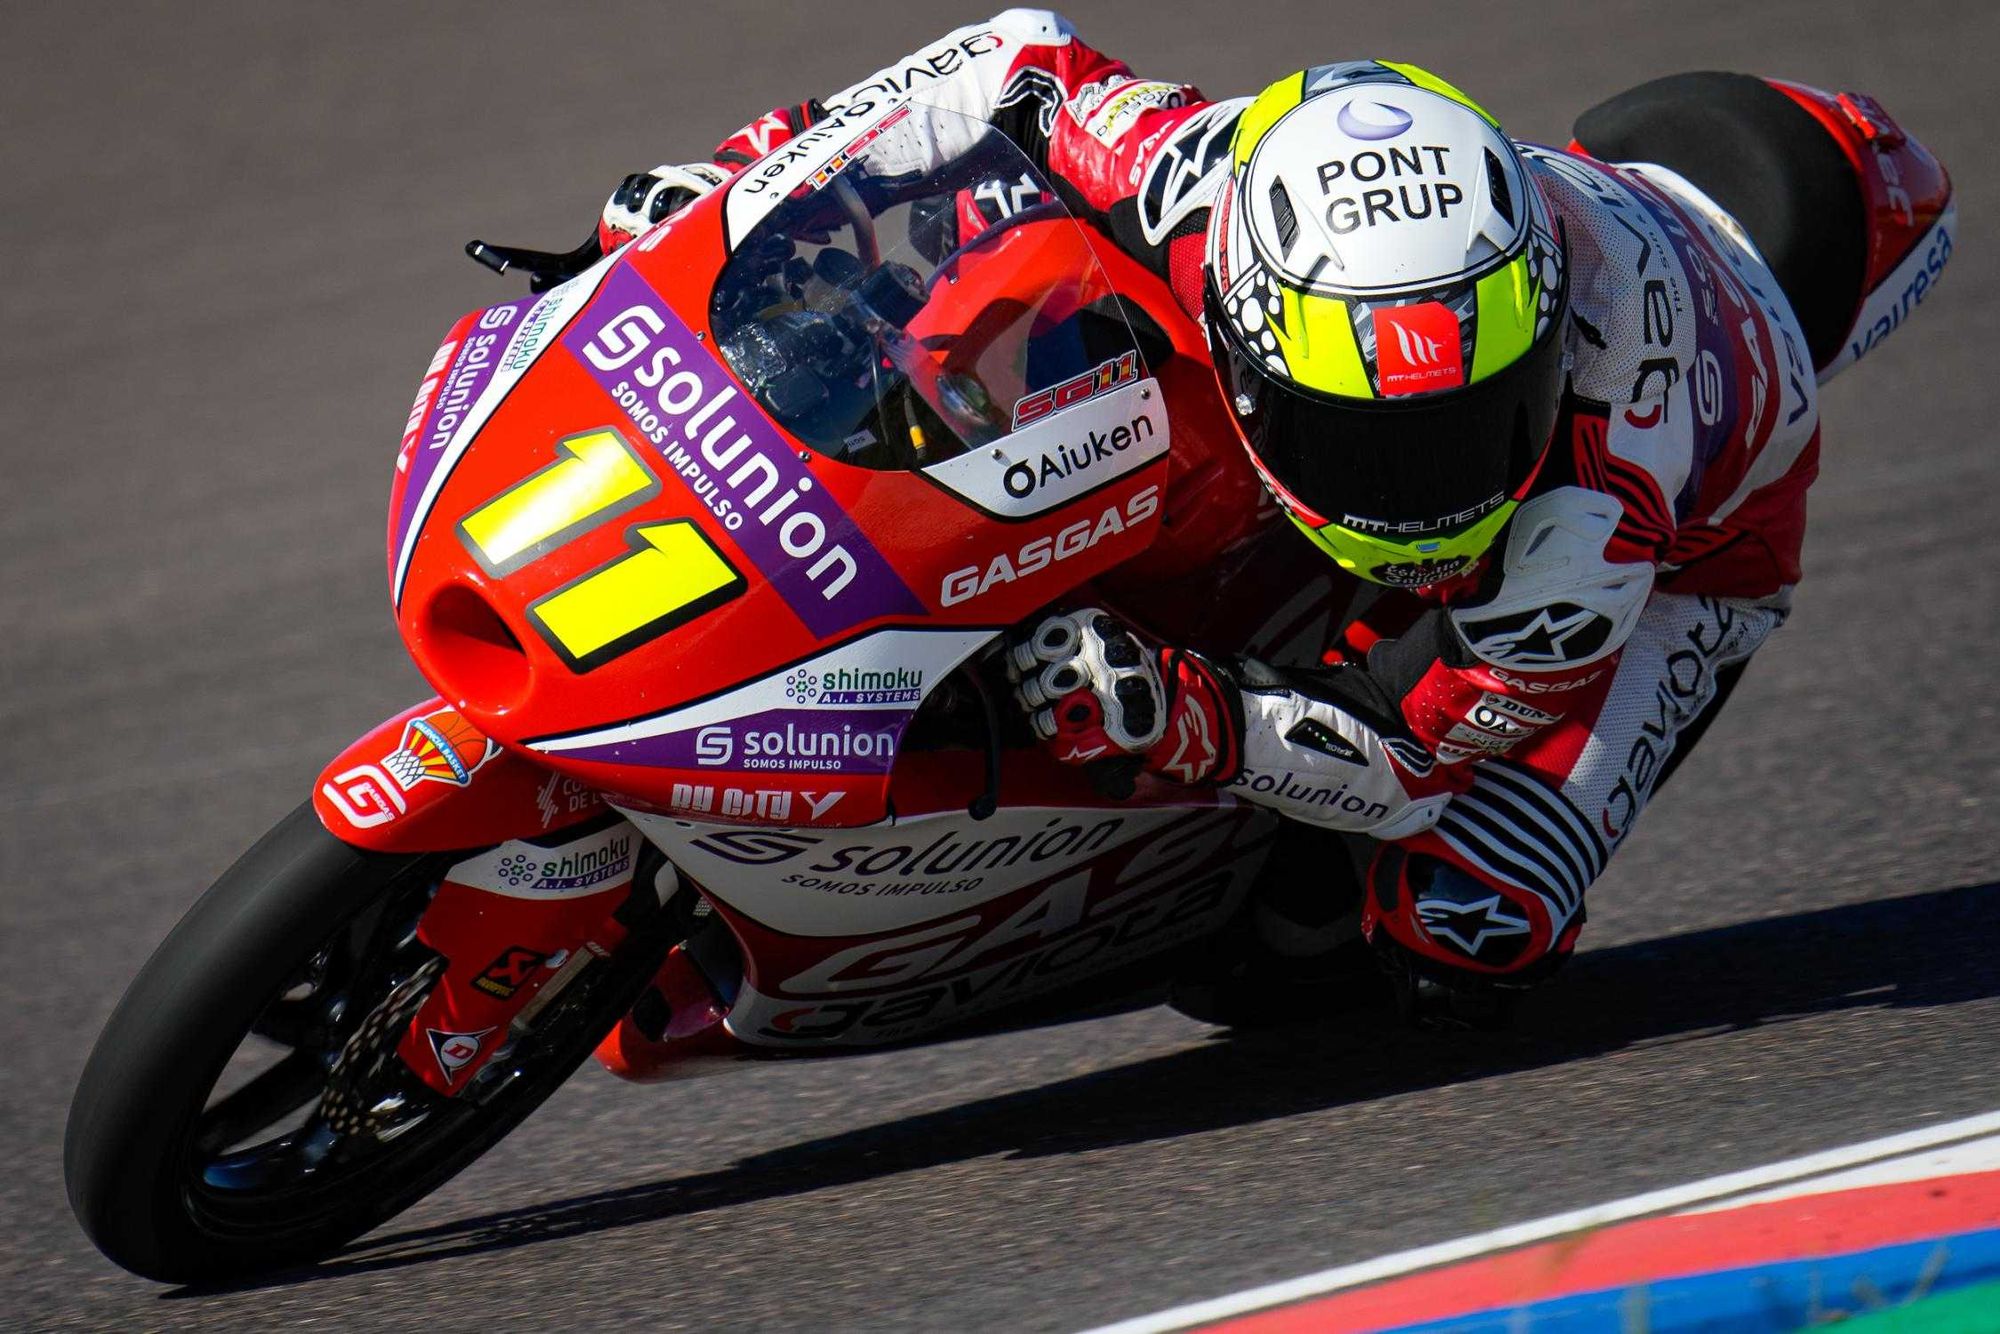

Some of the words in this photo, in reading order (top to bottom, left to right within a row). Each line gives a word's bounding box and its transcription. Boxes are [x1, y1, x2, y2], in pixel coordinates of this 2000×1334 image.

[744, 117, 846, 194] Aiuken
[1316, 145, 1450, 196] PONT
[1325, 183, 1464, 235] GRUP
[1852, 224, 1954, 361] vairesa
[428, 333, 498, 450] solunion
[1012, 350, 1139, 432] SG11
[611, 381, 669, 444] SOMOS
[663, 440, 744, 532] IMPULSO
[633, 345, 858, 601] solunion
[1038, 413, 1154, 489] Aiuken
[456, 427, 745, 666] 11
[940, 485, 1160, 608] GASGAS
[821, 693, 849, 704] A.I.
[855, 690, 921, 704] SYSTEMS
[822, 667, 923, 691] shimoku
[442, 745, 467, 781] BASKET
[743, 722, 895, 758] solunion
[743, 758, 786, 770] SOMOS
[788, 758, 842, 771] IMPULSO
[1232, 767, 1389, 820] solunion
[541, 836, 630, 878] shimoku
[573, 858, 630, 888] SYSTEMS
[807, 817, 1125, 878] solunion
[781, 872, 872, 897] SOMOS
[876, 876, 986, 897] IMPULSO
